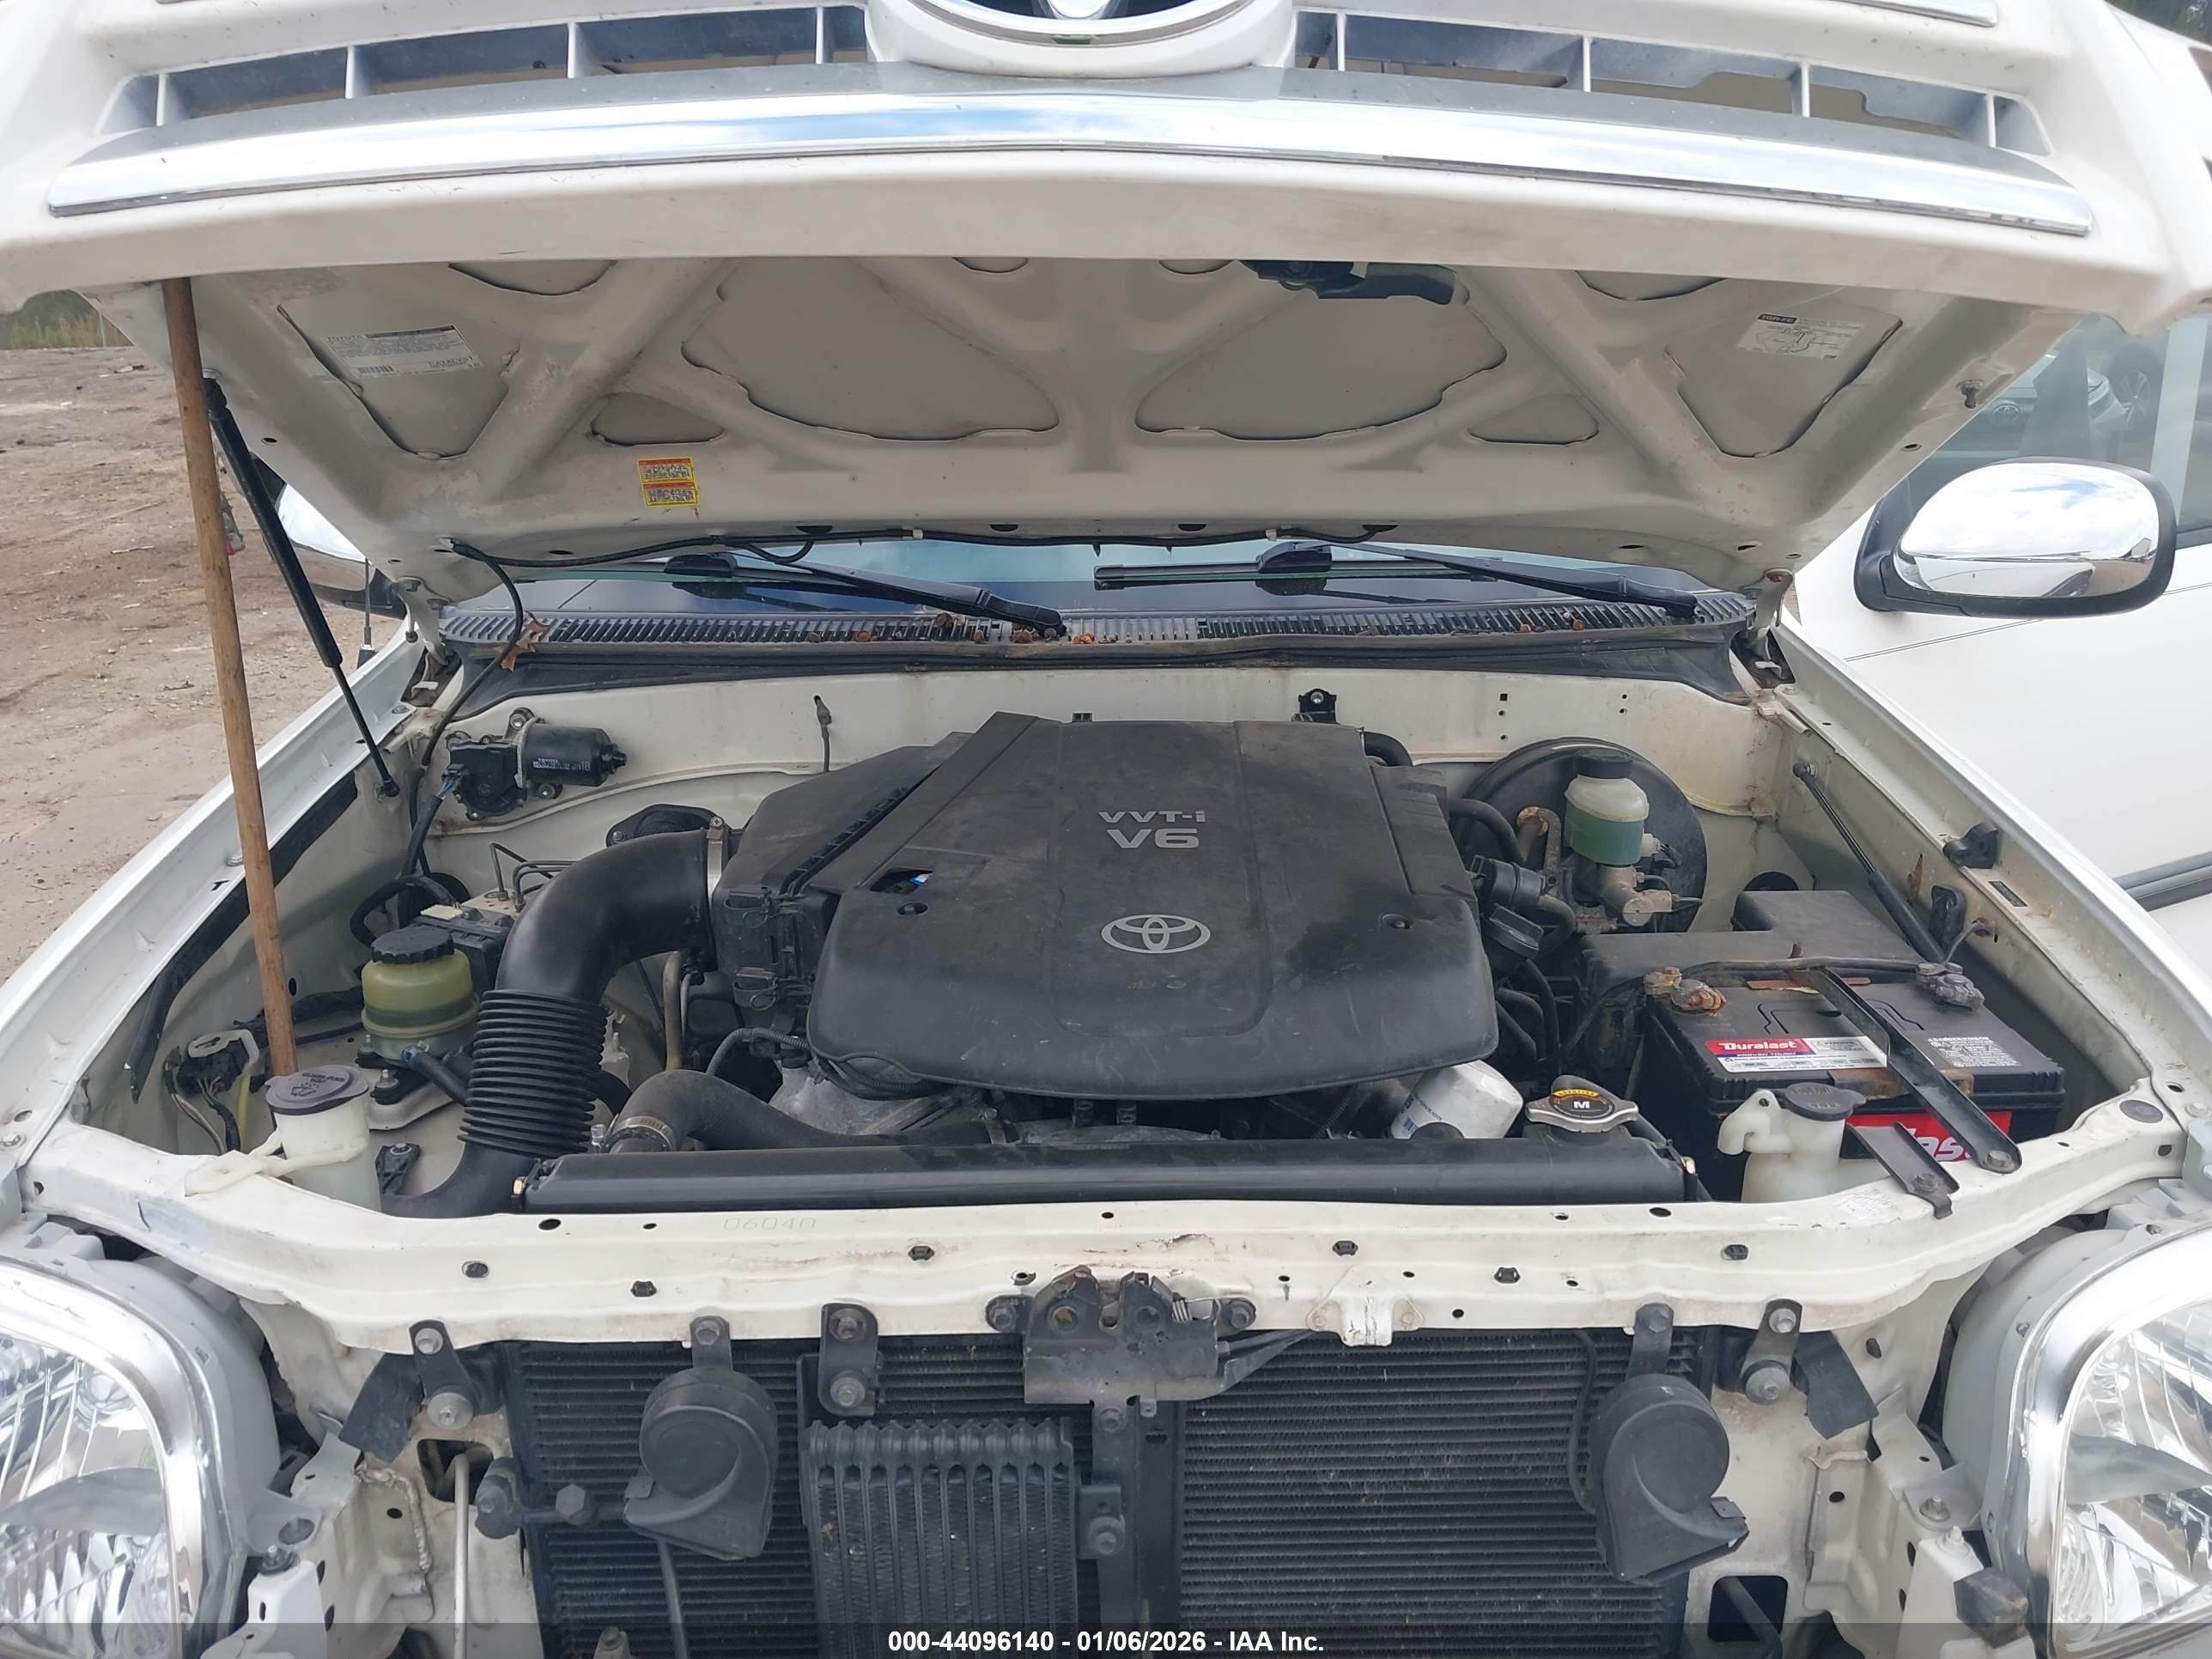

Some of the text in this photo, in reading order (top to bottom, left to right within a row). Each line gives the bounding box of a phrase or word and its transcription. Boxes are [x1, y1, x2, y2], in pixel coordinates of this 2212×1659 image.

[1098, 810, 1207, 823] VVT-i
[1106, 828, 1200, 849] V6
[1718, 1041, 1798, 1051] Duralast
